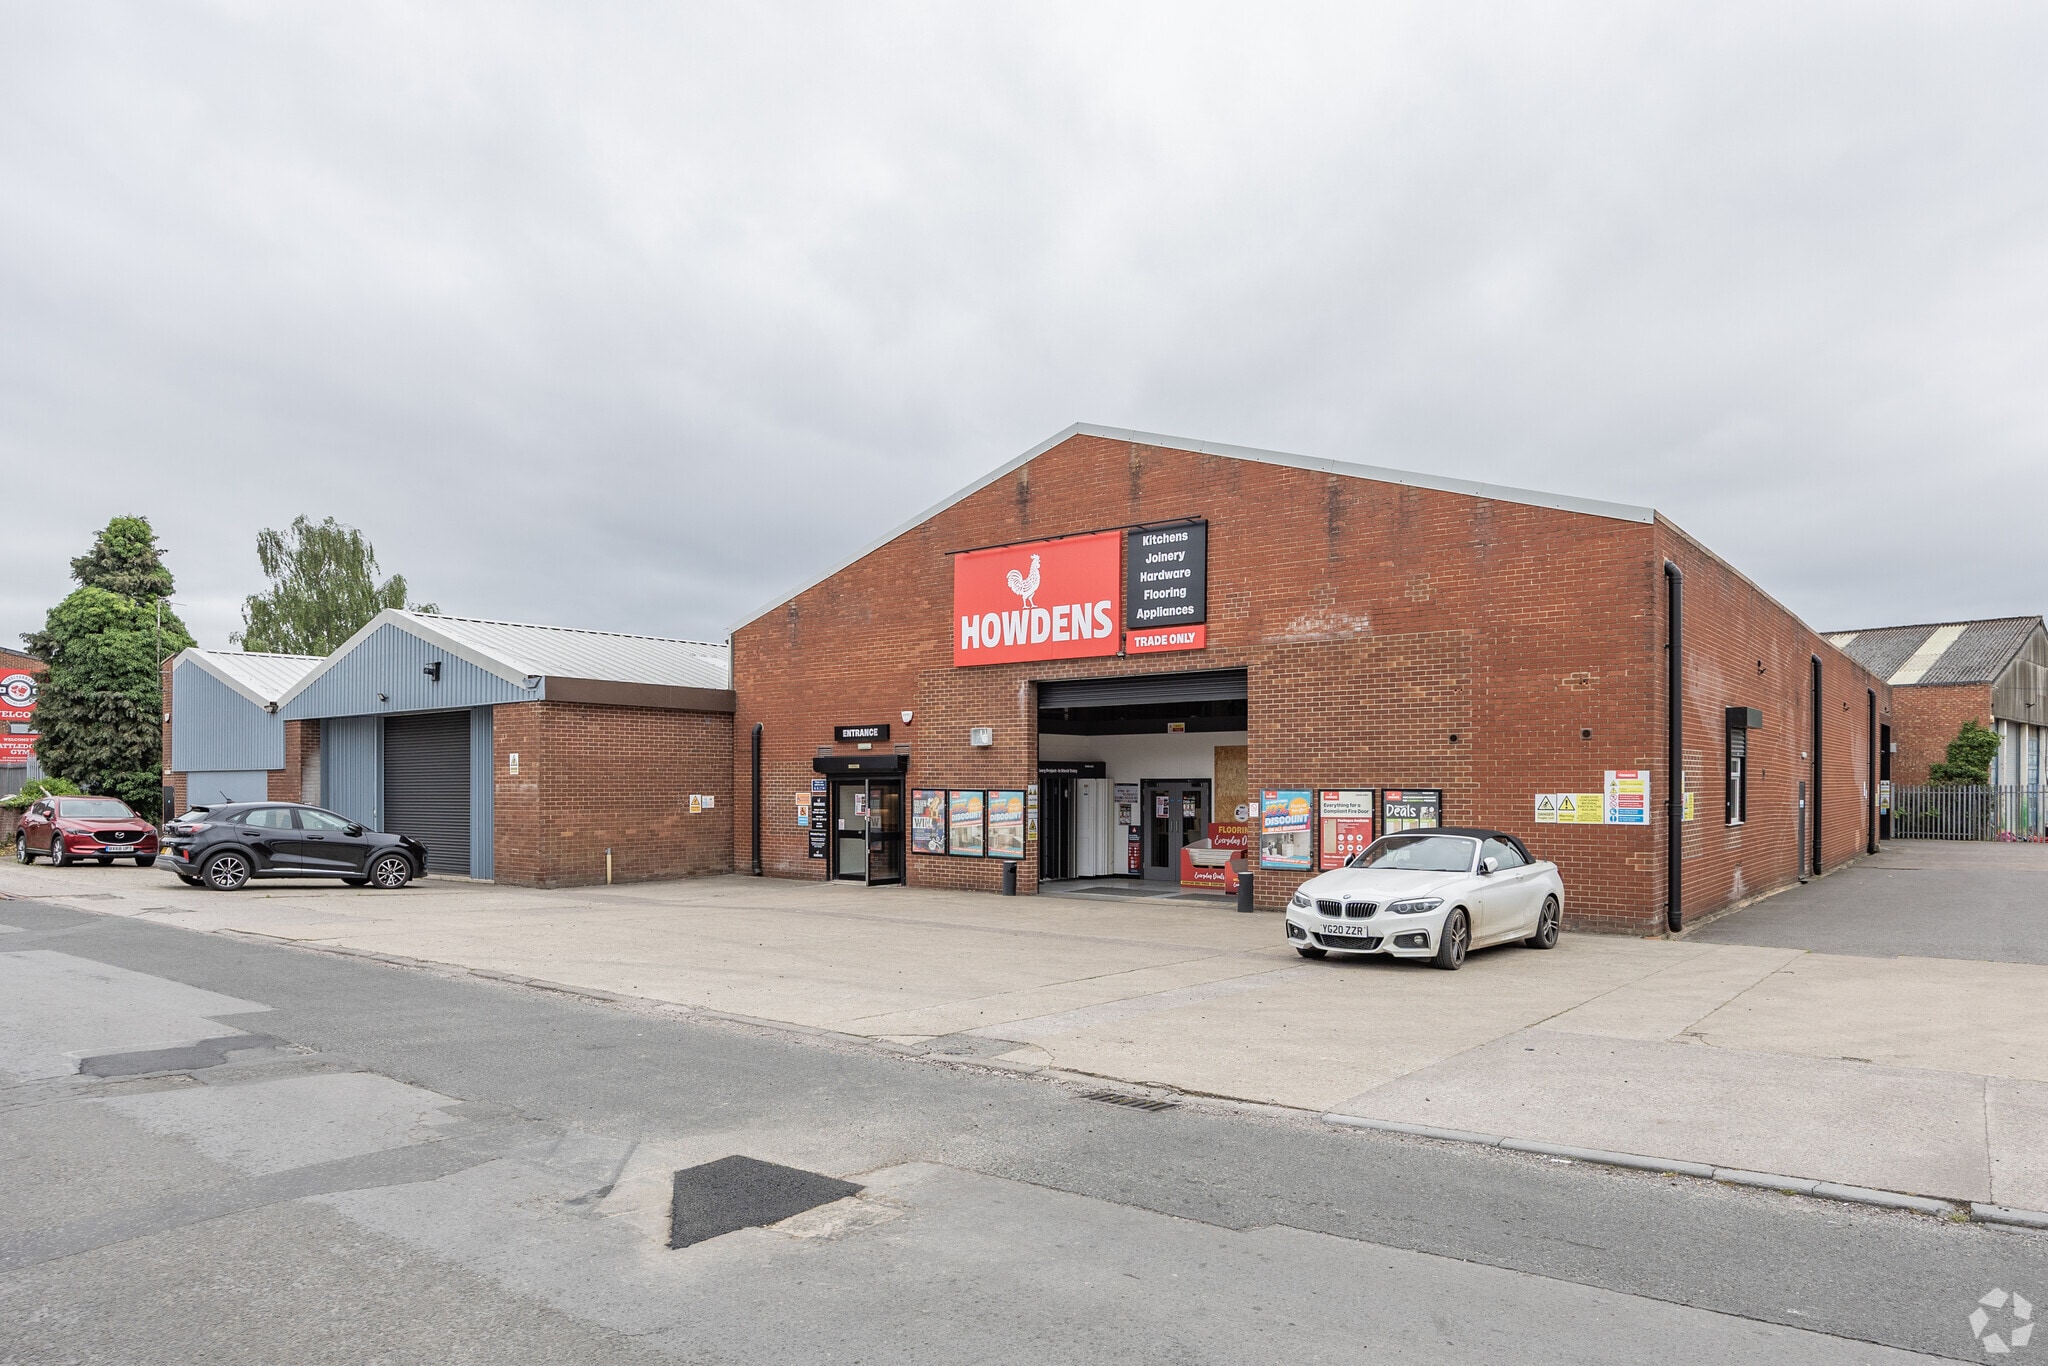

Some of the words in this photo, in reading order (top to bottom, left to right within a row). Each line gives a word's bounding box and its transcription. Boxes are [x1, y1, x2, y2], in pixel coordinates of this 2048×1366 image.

[1142, 530, 1188, 546] Kitchens
[1145, 550, 1185, 564] Joinery
[1140, 567, 1191, 582] Hardware
[1143, 586, 1187, 600] Flooring
[1136, 604, 1195, 620] Appliances
[961, 600, 1113, 649] HOWDENS
[1134, 635, 1168, 648] TRADE
[1169, 632, 1196, 645] ONLY
[842, 728, 879, 738] ENTRANCE
[1266, 803, 1288, 816] 10%
[1386, 804, 1416, 817] Deals
[951, 812, 982, 821] DISCOUNT
[990, 812, 1022, 821] DISCOUNT
[1265, 814, 1309, 826] DISCOUNT
[1214, 835, 1240, 845] Everyday
[1194, 872, 1212, 880] Everyday
[1212, 872, 1225, 880] Deals
[1322, 924, 1343, 934] YG20
[1345, 926, 1362, 935] ZZR
